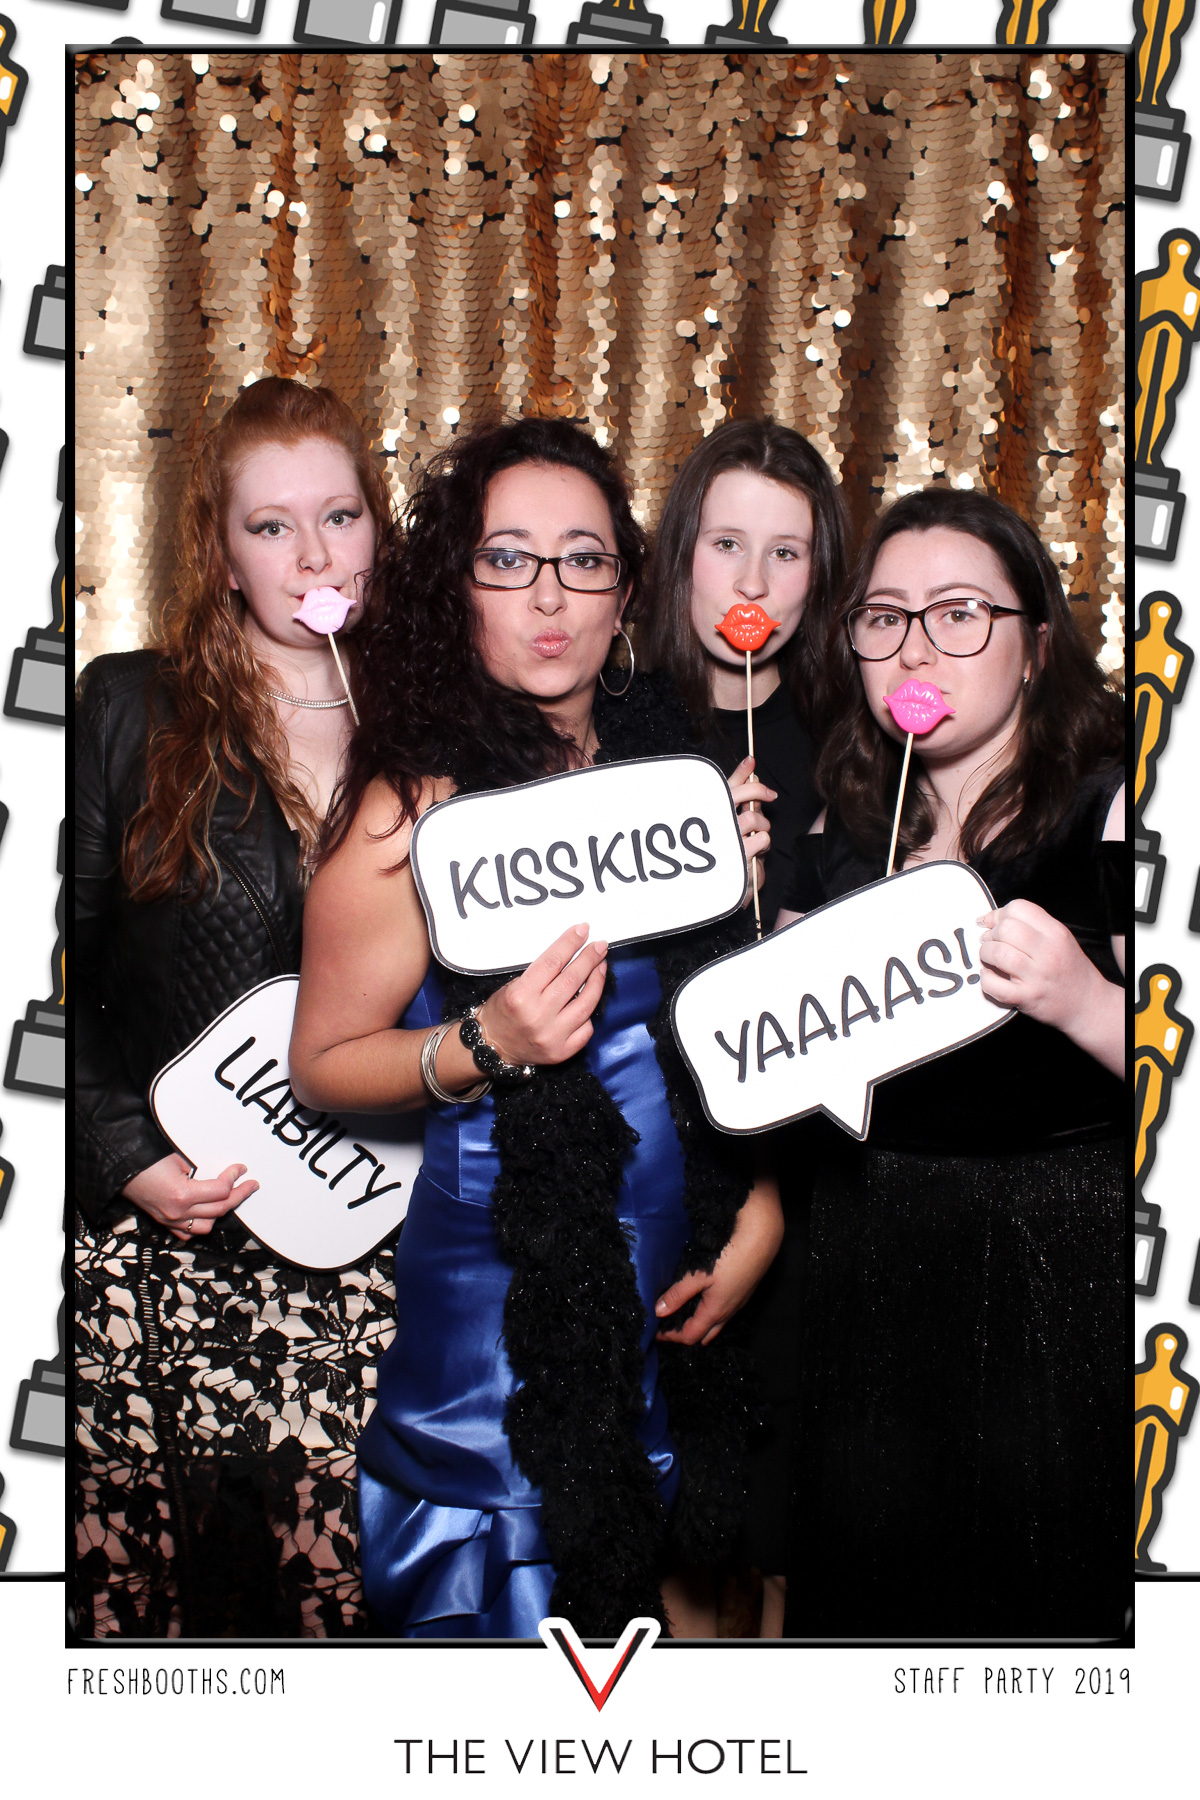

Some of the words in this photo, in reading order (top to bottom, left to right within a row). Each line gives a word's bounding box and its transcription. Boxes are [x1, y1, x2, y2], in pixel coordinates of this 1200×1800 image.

[449, 840, 585, 919] KISS
[587, 816, 716, 893] KISS
[714, 927, 981, 1083] YAAAAS!
[214, 1036, 402, 1209] LIABILTY
